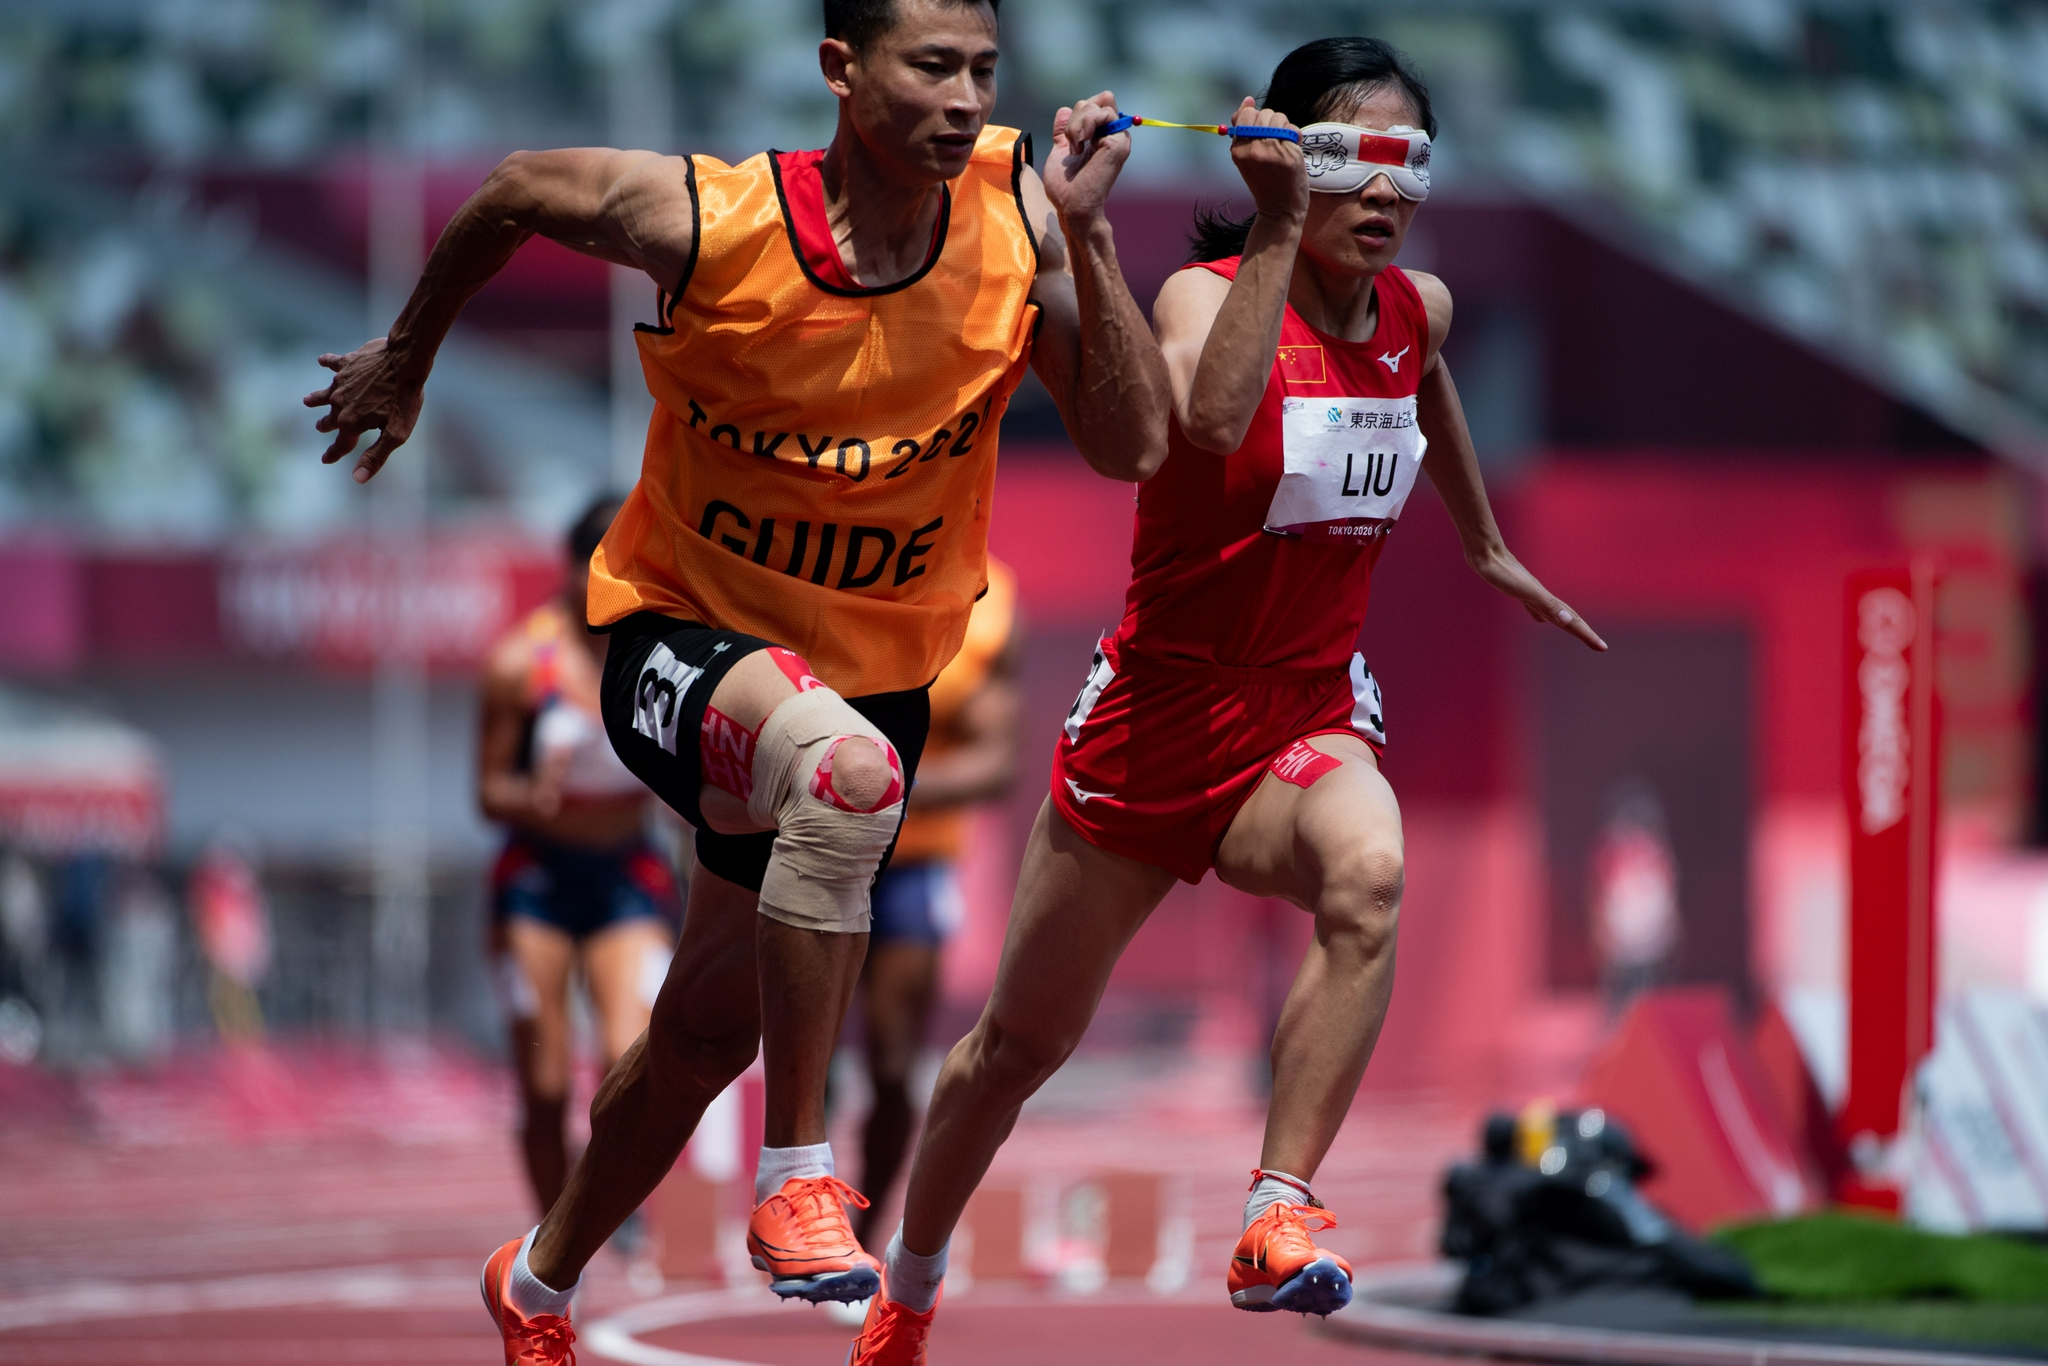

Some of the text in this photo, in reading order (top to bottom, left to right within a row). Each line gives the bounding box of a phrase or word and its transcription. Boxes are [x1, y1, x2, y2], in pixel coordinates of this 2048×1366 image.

[688, 399, 871, 482] TOKYO
[1341, 454, 1398, 497] LIU
[699, 500, 943, 590] GUIDE
[1328, 526, 1373, 536] TOKYO 2020
[639, 668, 677, 728] 3
[1274, 741, 1321, 778] HN
